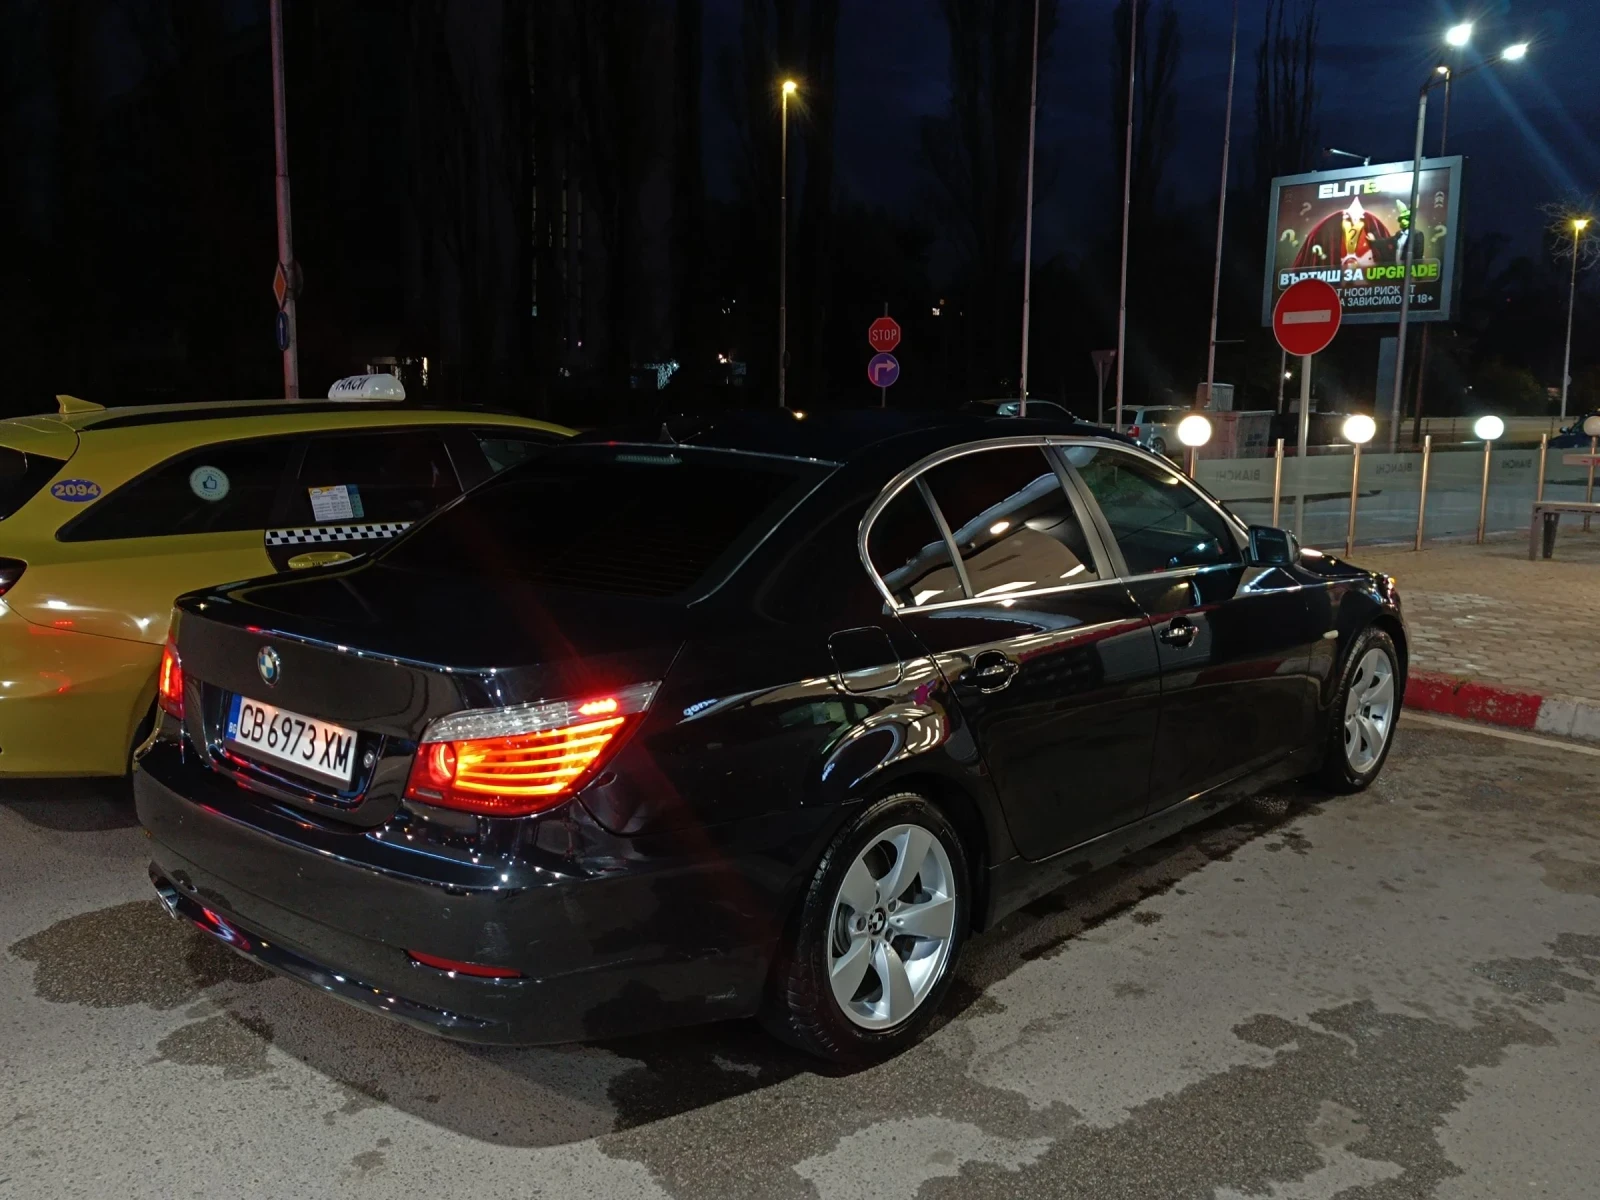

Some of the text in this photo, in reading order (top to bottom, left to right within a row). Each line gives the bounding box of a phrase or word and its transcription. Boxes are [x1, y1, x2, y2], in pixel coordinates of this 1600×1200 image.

[1343, 268, 1364, 281] ЗА
[1344, 287, 1372, 297] НОСИ
[1374, 285, 1401, 295] РИСК
[1347, 295, 1416, 306] ЗАВИСИМОТ
[1417, 294, 1434, 303] 18+
[872, 329, 897, 341] STOP
[54, 484, 99, 496] 2094
[228, 721, 238, 735] BG
[267, 713, 318, 761] 6973
